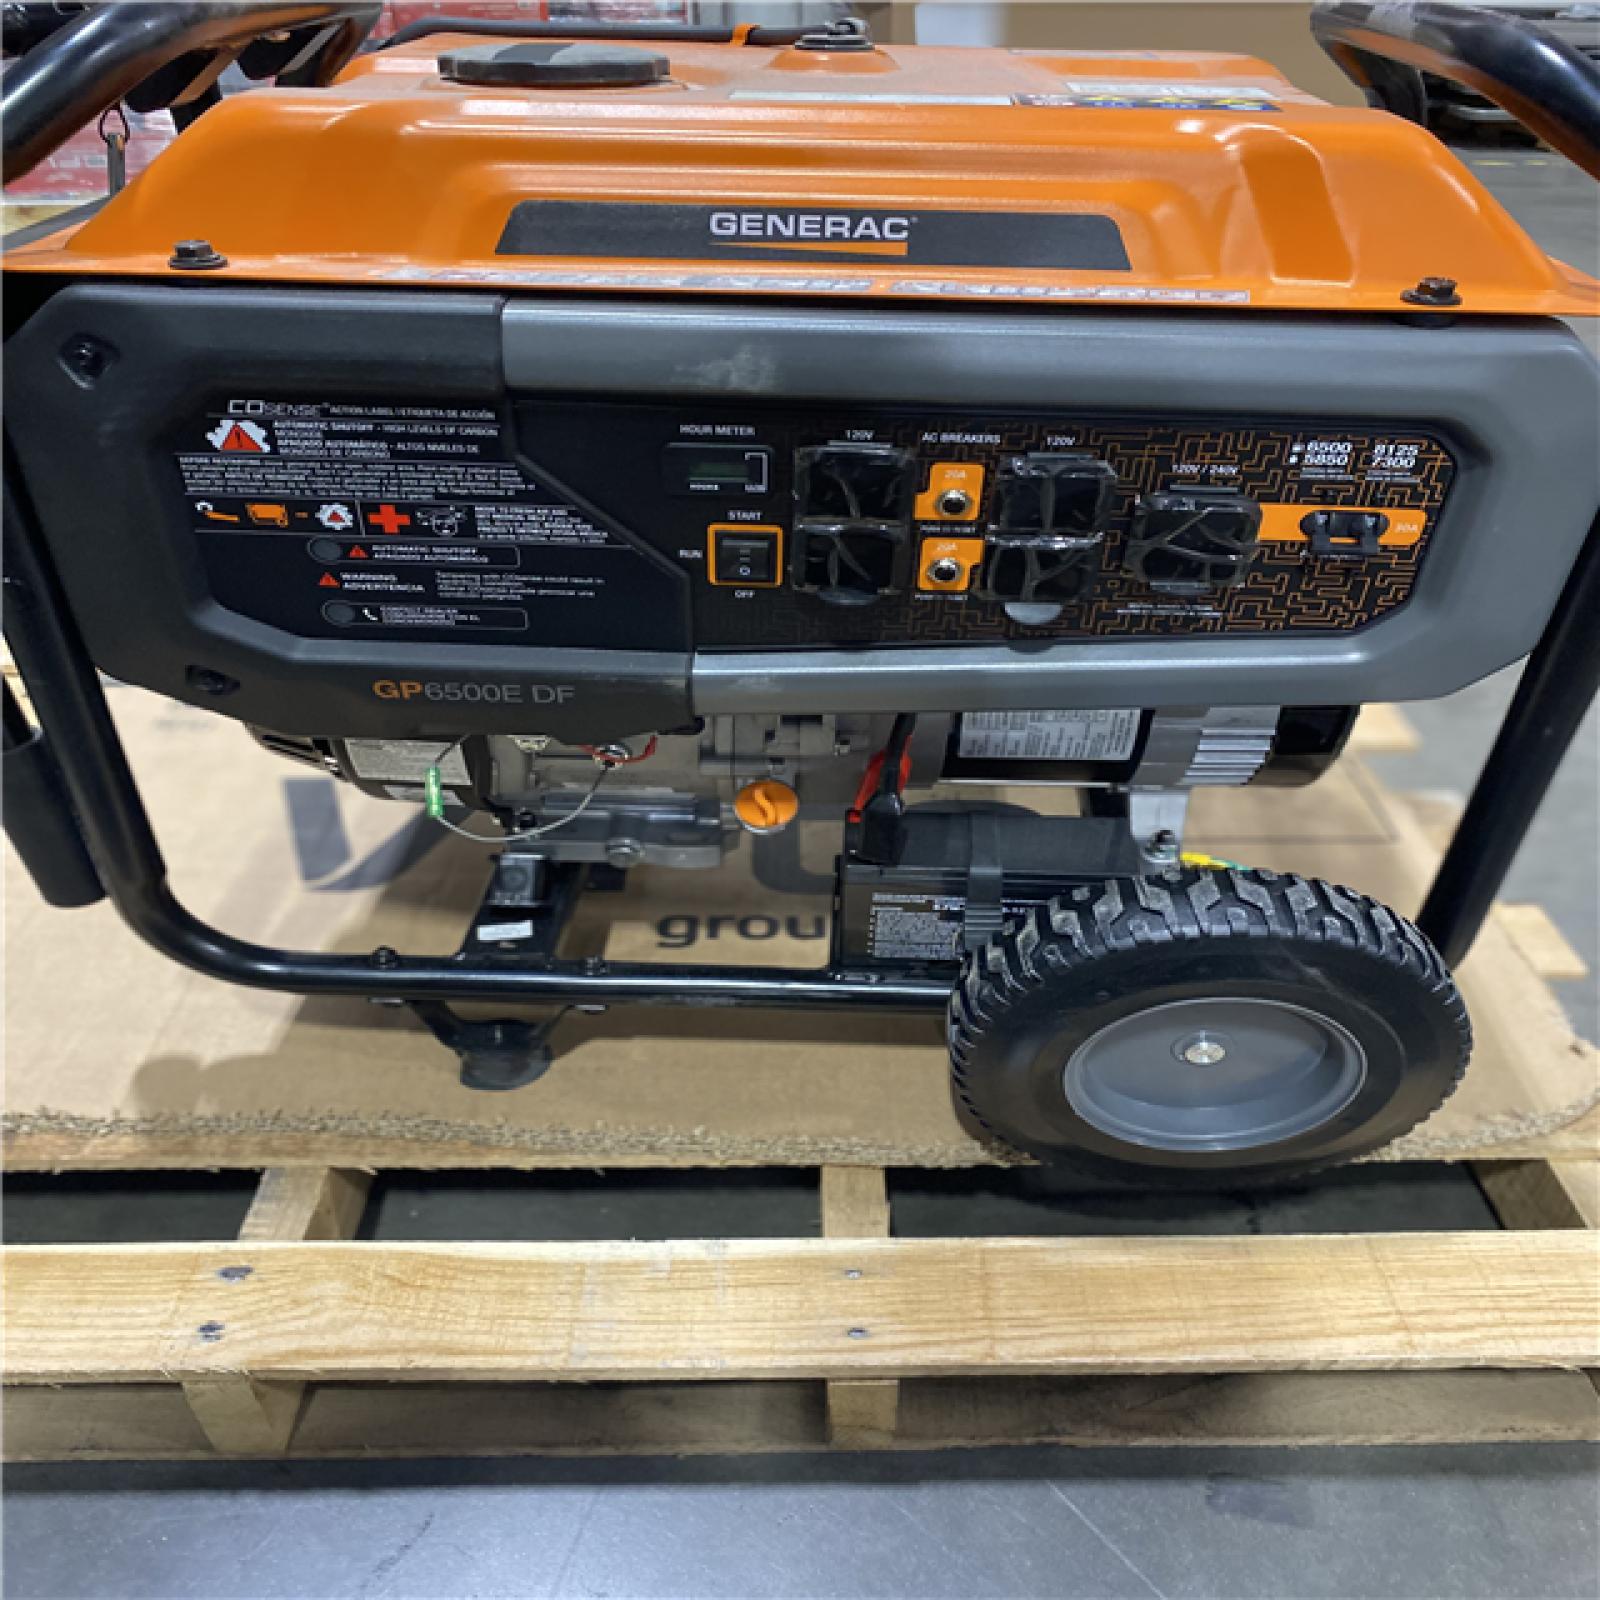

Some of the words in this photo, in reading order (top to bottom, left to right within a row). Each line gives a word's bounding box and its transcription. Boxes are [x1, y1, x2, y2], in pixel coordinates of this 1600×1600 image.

[709, 212, 910, 240] GENERAC
[680, 424, 713, 436] HOUR
[714, 425, 755, 436] METER
[845, 429, 875, 441] 120V
[922, 432, 938, 443] AC
[939, 433, 1001, 444] BREAKERS
[1047, 436, 1076, 447] 120V
[727, 510, 762, 521] START
[679, 549, 703, 559] RUN
[734, 589, 755, 599] OFF
[372, 679, 523, 703] GP6500E
[532, 684, 576, 704] DF
